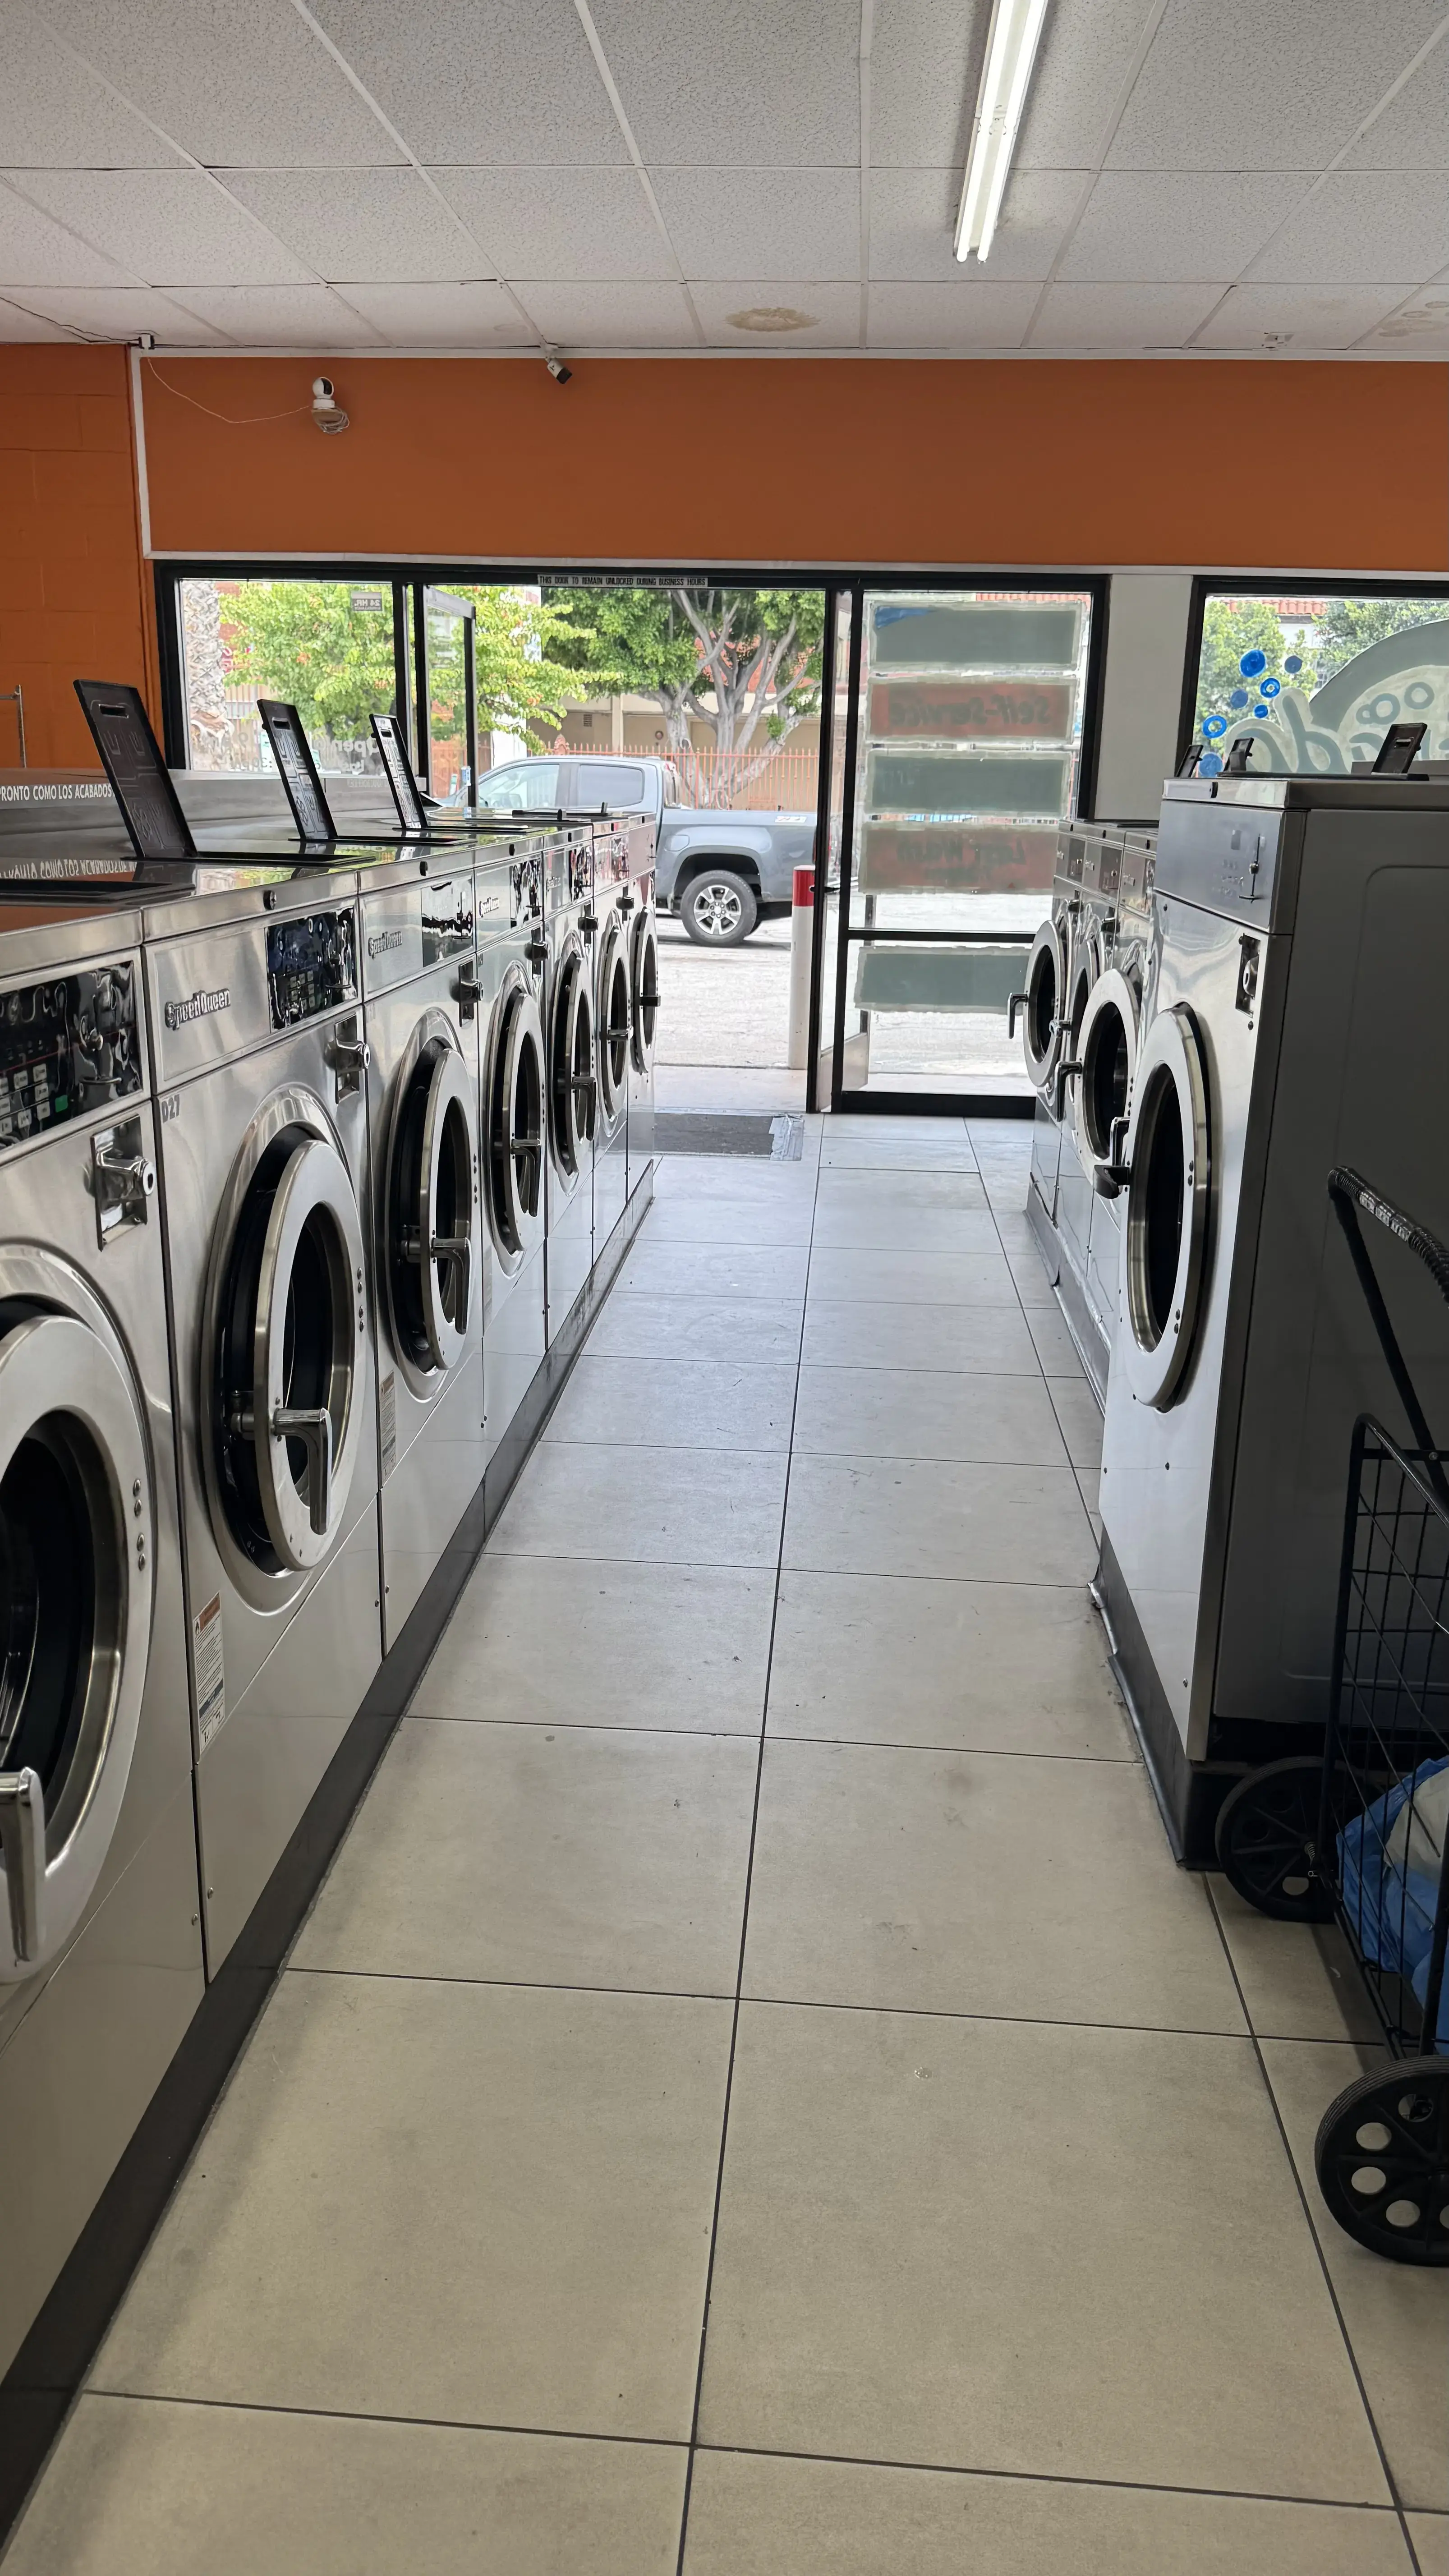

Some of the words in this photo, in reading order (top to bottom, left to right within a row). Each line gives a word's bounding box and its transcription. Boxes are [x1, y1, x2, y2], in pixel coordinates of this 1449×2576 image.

[540, 576, 552, 584] THIS
[555, 576, 569, 584] DOOR
[572, 576, 579, 584] TO
[582, 577, 603, 585] REMAIN
[606, 577, 634, 585] UNLOCKED
[636, 577, 656, 586] DURING
[658, 578, 684, 586] BUSINESS
[0, 785, 30, 801] RONTO
[33, 785, 57, 800] COMO
[59, 784, 73, 800] LOS
[74, 783, 112, 799] ACABADOS
